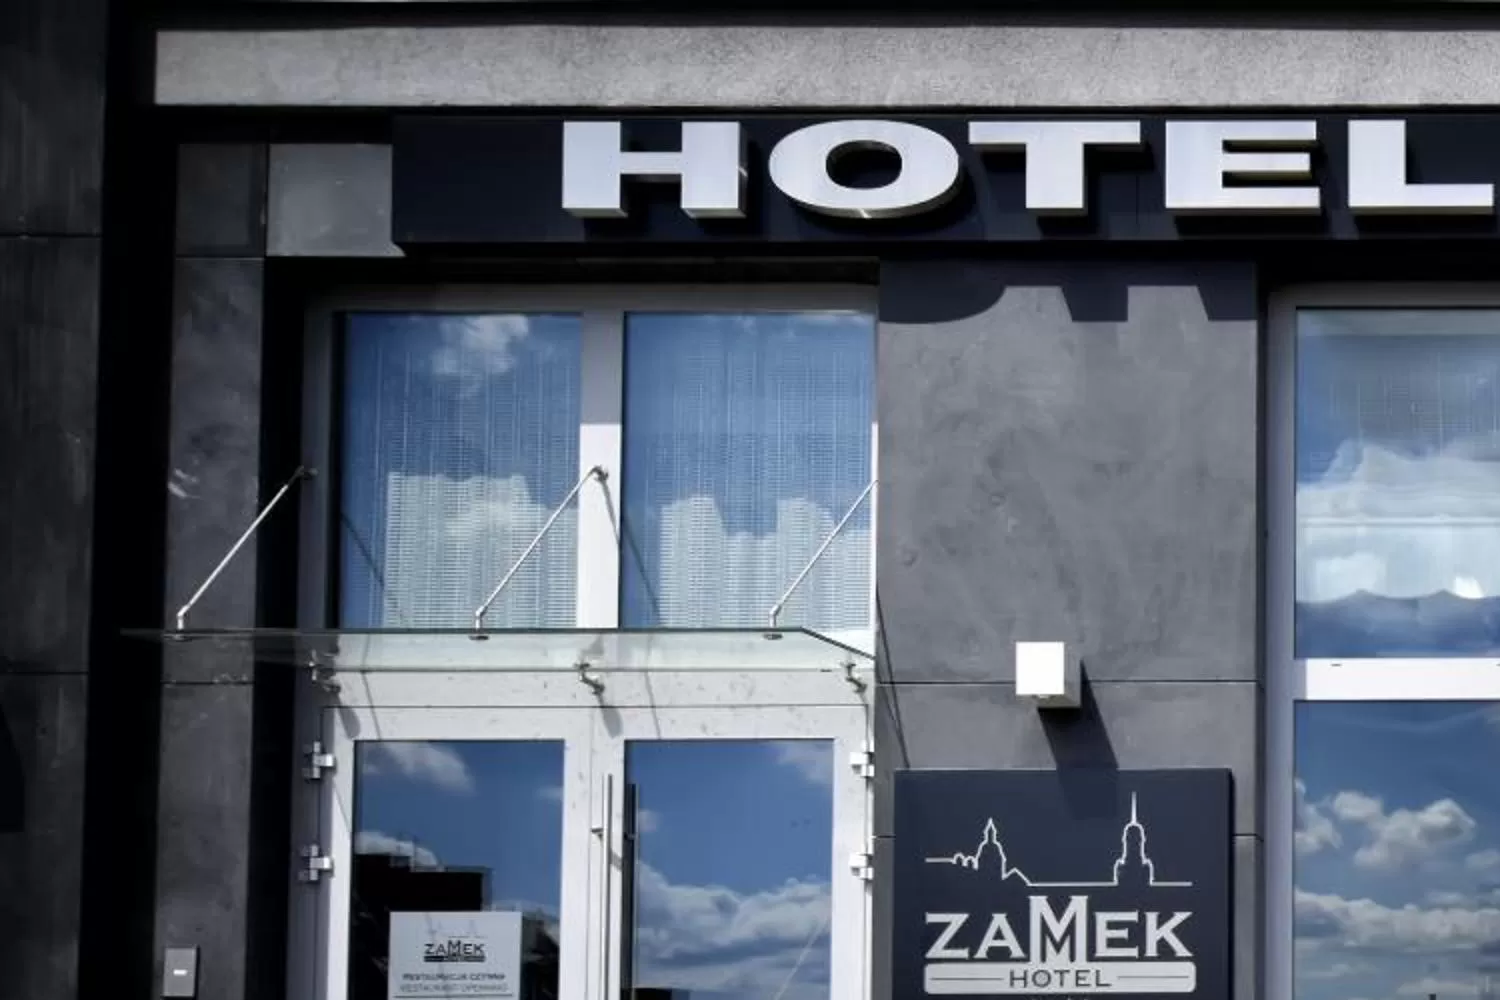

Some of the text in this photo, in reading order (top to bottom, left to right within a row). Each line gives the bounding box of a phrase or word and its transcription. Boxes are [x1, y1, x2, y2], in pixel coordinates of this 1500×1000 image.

[561, 119, 1494, 219] HOTEL
[423, 940, 486, 956] ZAMEK
[925, 895, 1194, 963] ZAMEK
[1008, 969, 1112, 988] HOTEL
